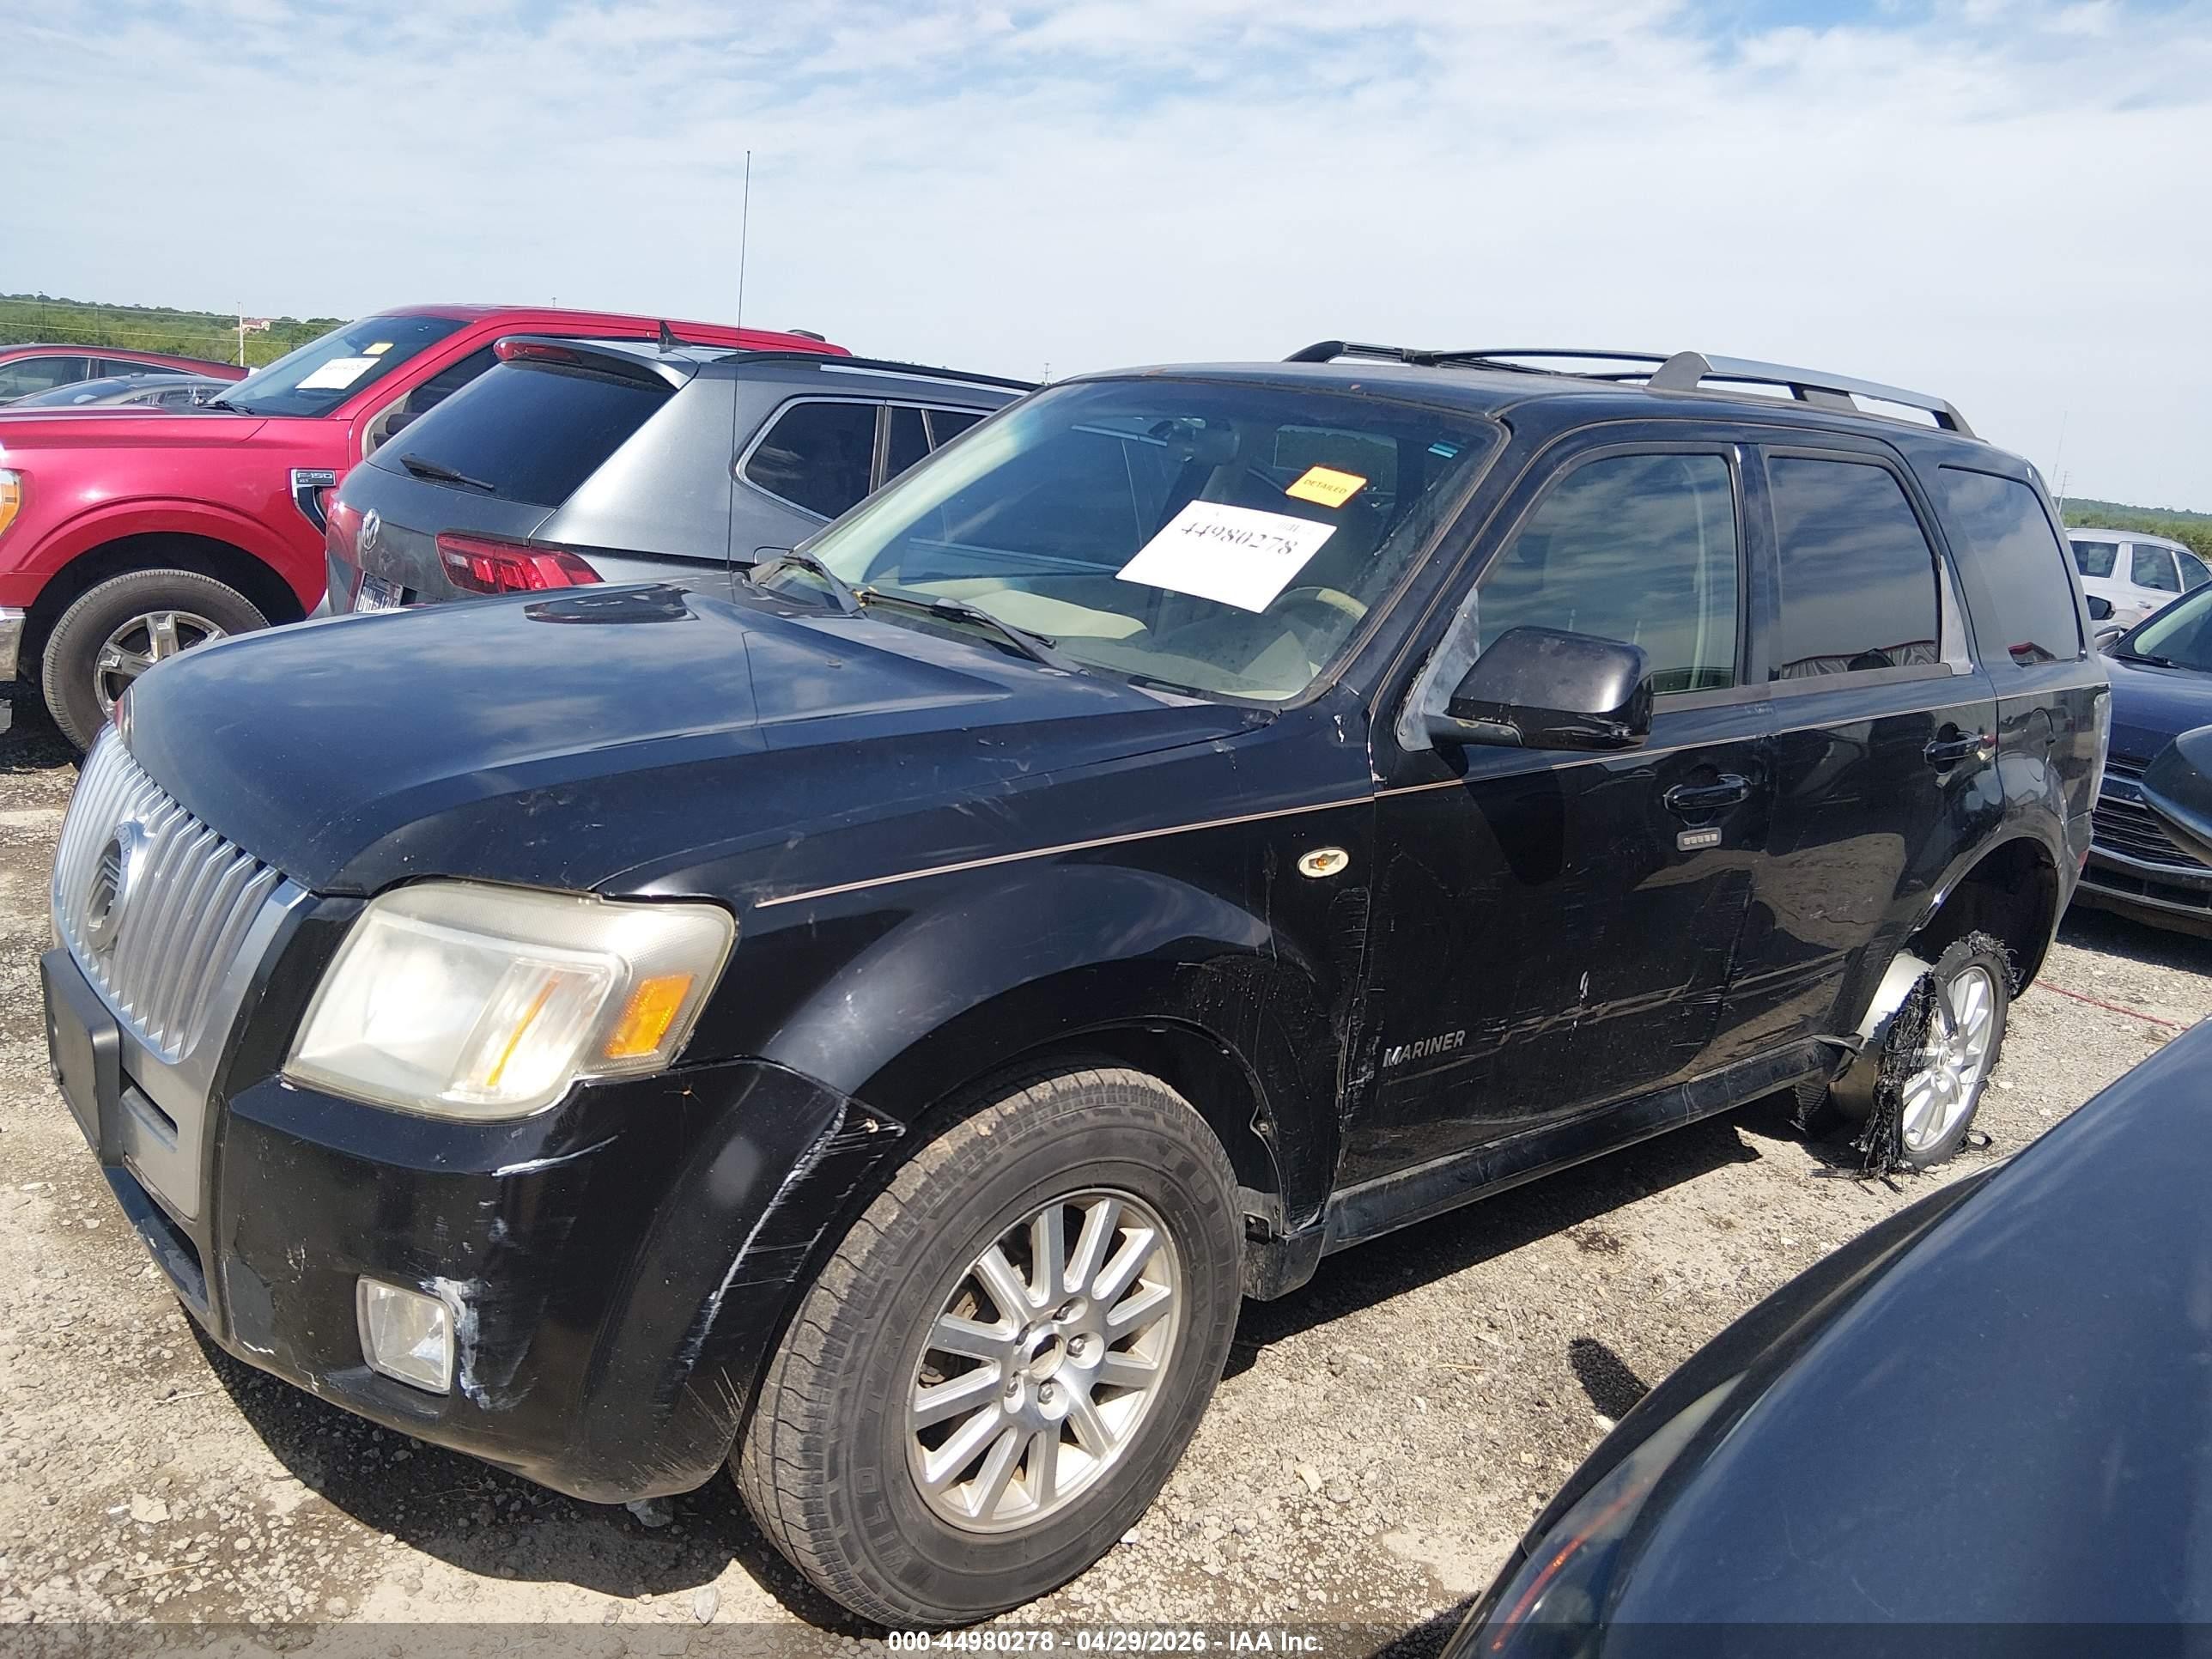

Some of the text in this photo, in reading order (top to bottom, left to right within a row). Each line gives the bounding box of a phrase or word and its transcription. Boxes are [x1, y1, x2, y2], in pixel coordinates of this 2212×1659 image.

[1304, 479, 1347, 495] DETAILED
[1181, 521, 1298, 556] 44980278
[1382, 1030, 1466, 1068] MARINER
[854, 1468, 912, 1577] WILD
